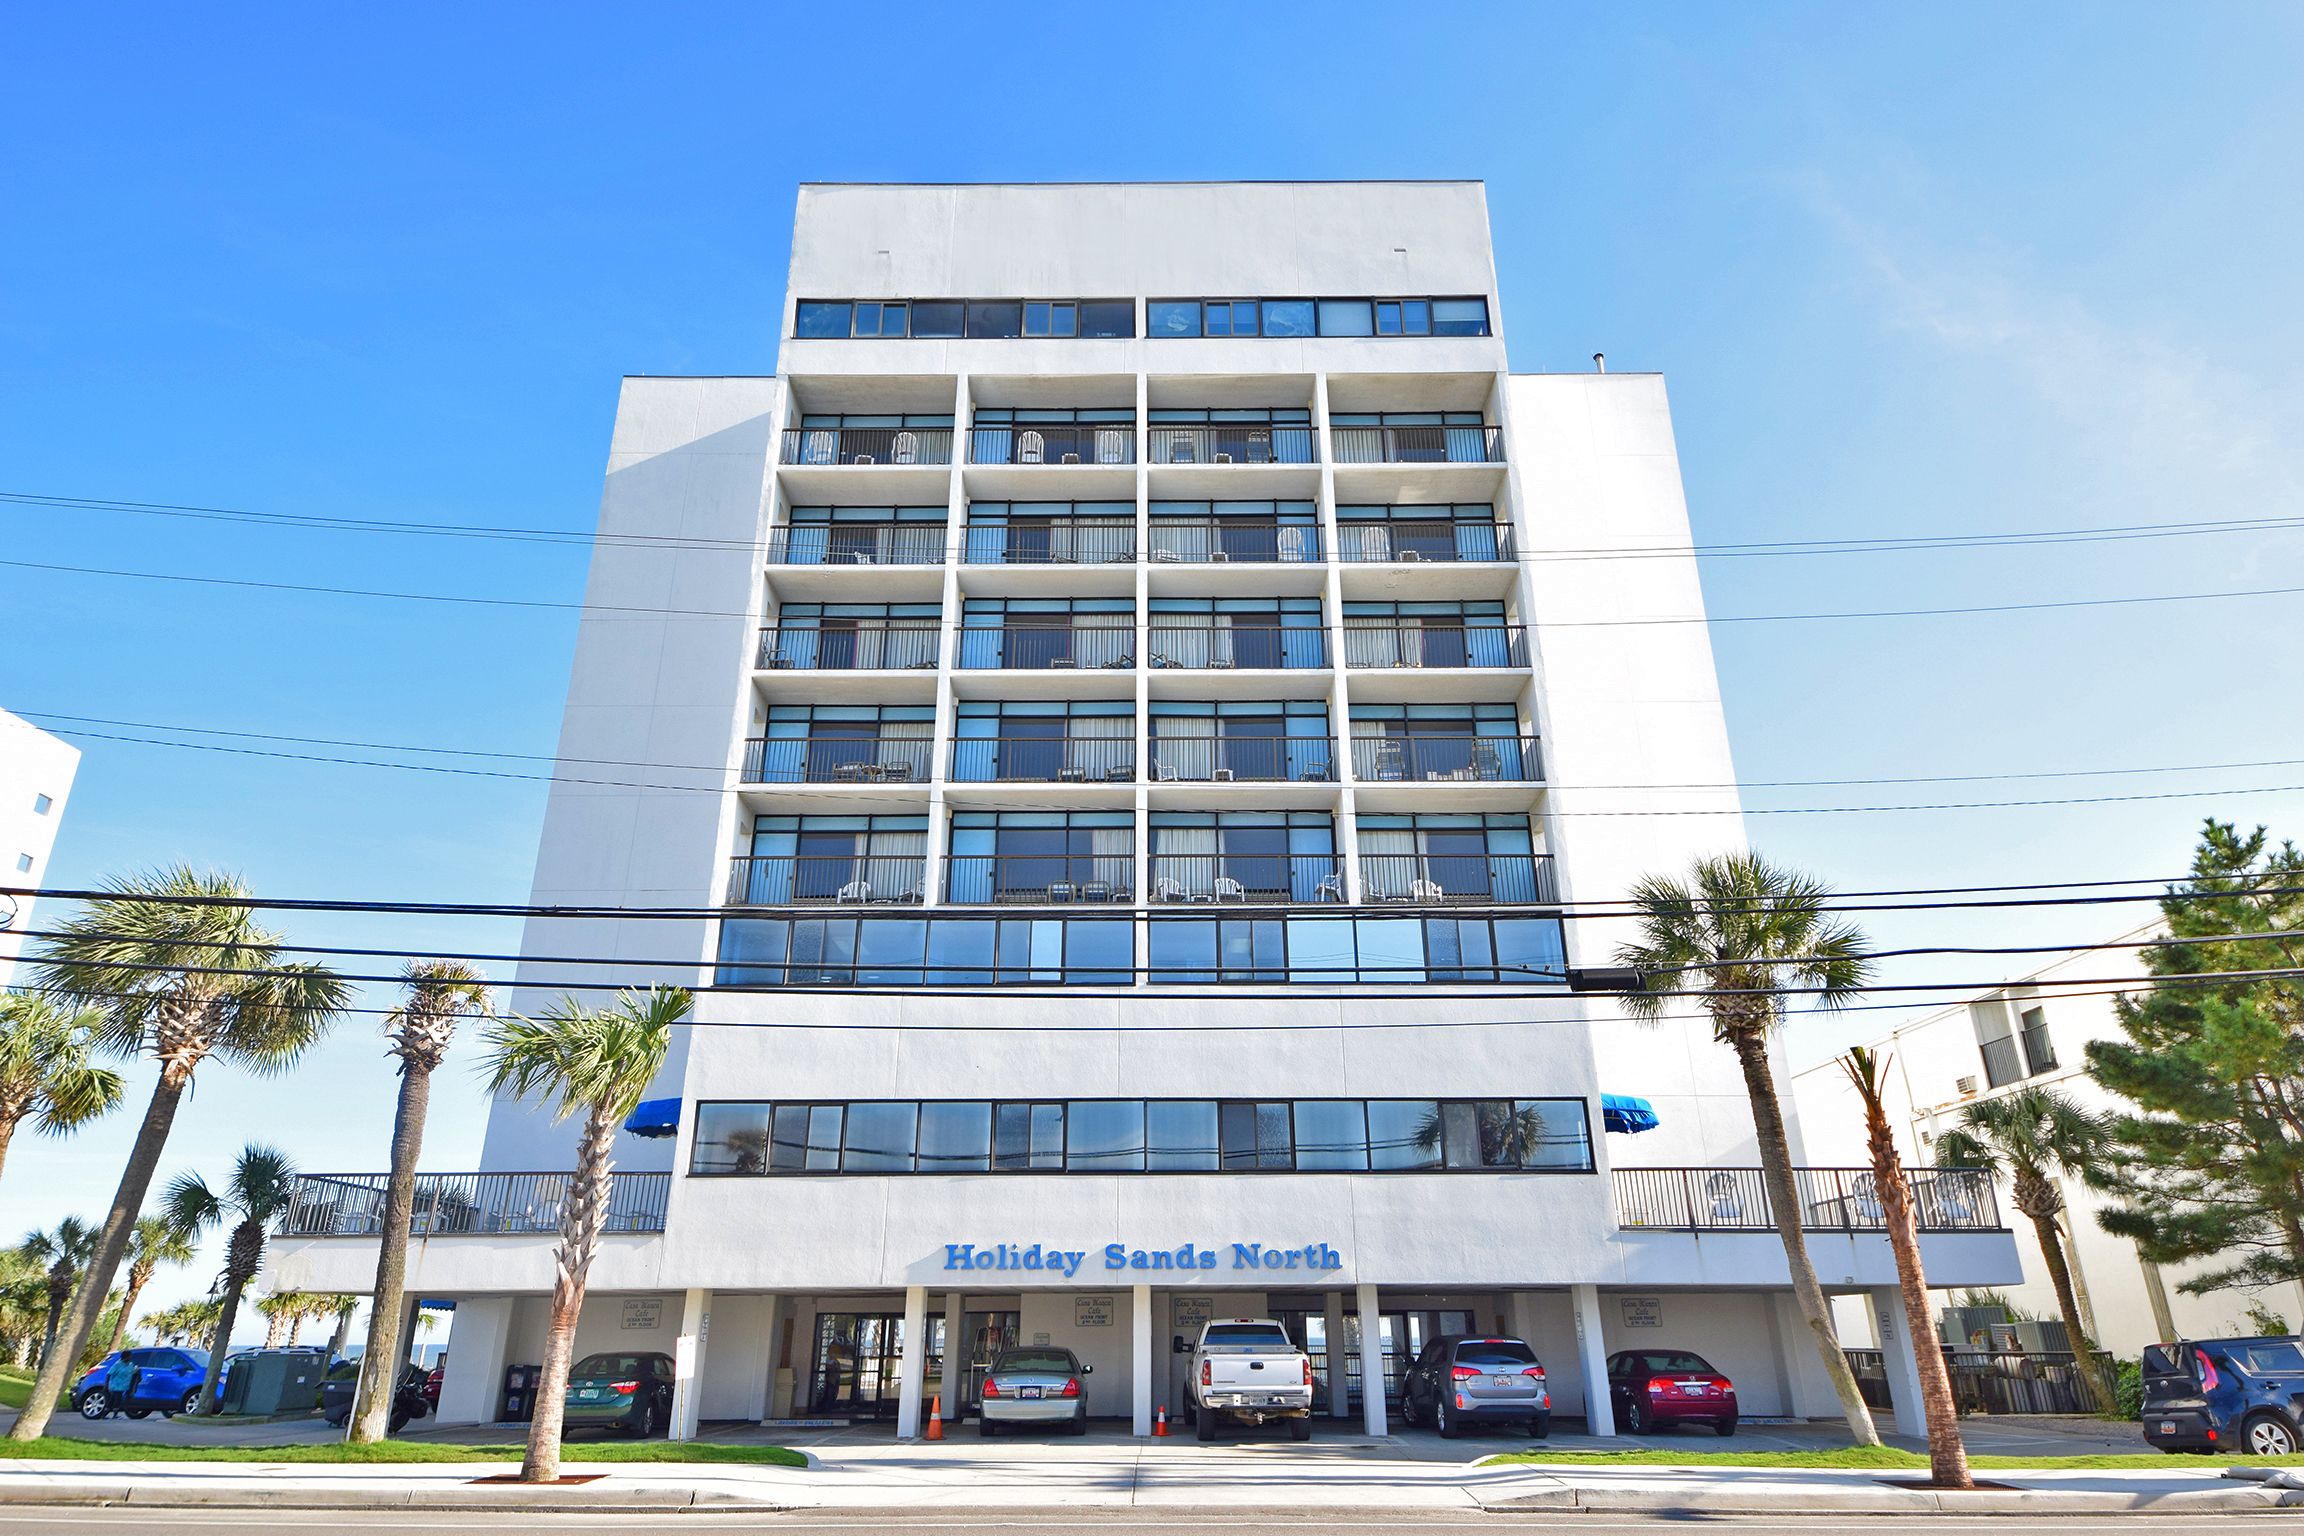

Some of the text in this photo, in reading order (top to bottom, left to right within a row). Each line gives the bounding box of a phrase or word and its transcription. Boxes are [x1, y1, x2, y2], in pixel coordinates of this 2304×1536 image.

[943, 1243, 1343, 1278] Holiday Sands North
